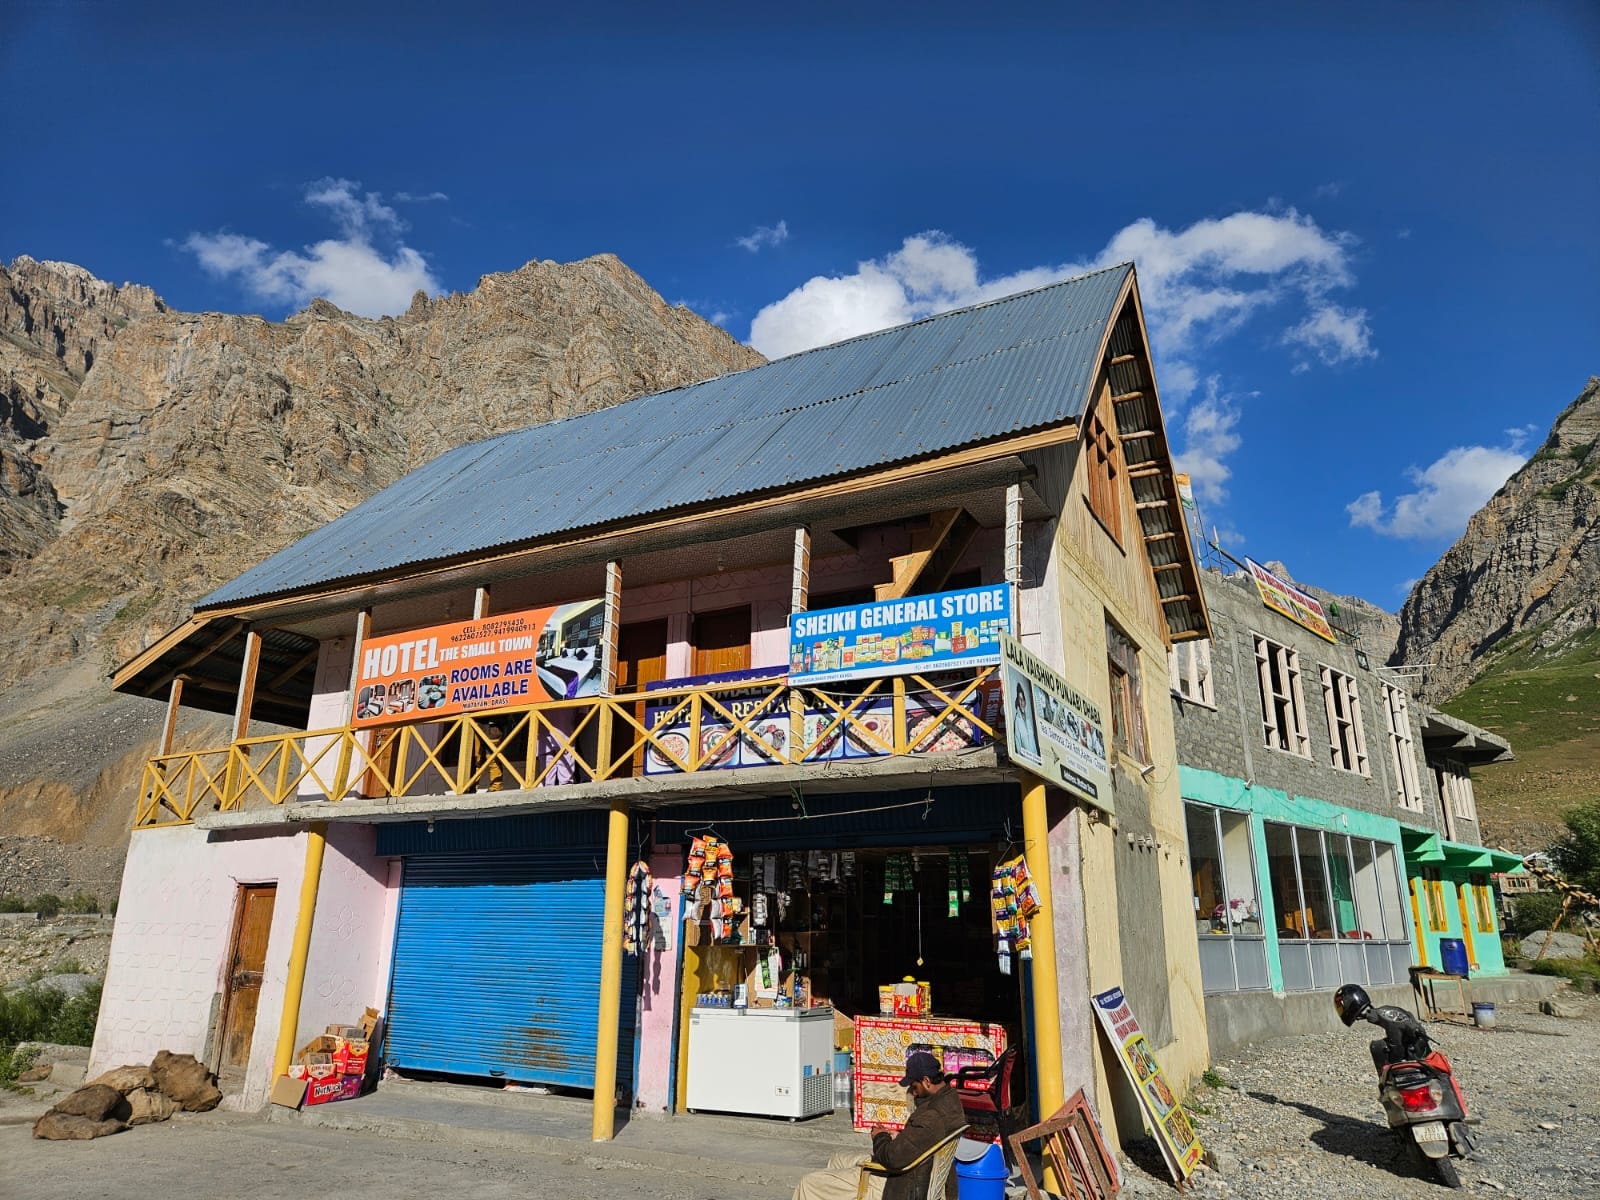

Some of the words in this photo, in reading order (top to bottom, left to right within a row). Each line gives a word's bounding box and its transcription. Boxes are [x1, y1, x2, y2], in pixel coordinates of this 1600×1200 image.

[795, 611, 856, 638] SHEIKH
[860, 599, 938, 628] GENERAL
[942, 590, 1003, 617] STORE
[362, 637, 439, 680] HOTEL
[440, 646, 459, 662] THE
[461, 640, 495, 658] SMALL
[499, 635, 533, 653] TOWN
[451, 664, 499, 683] ROOMS
[504, 659, 533, 677] ARE
[1005, 638, 1025, 670] LALA
[1025, 653, 1054, 692] VAISHNO
[452, 679, 528, 702] AVAILABLE
